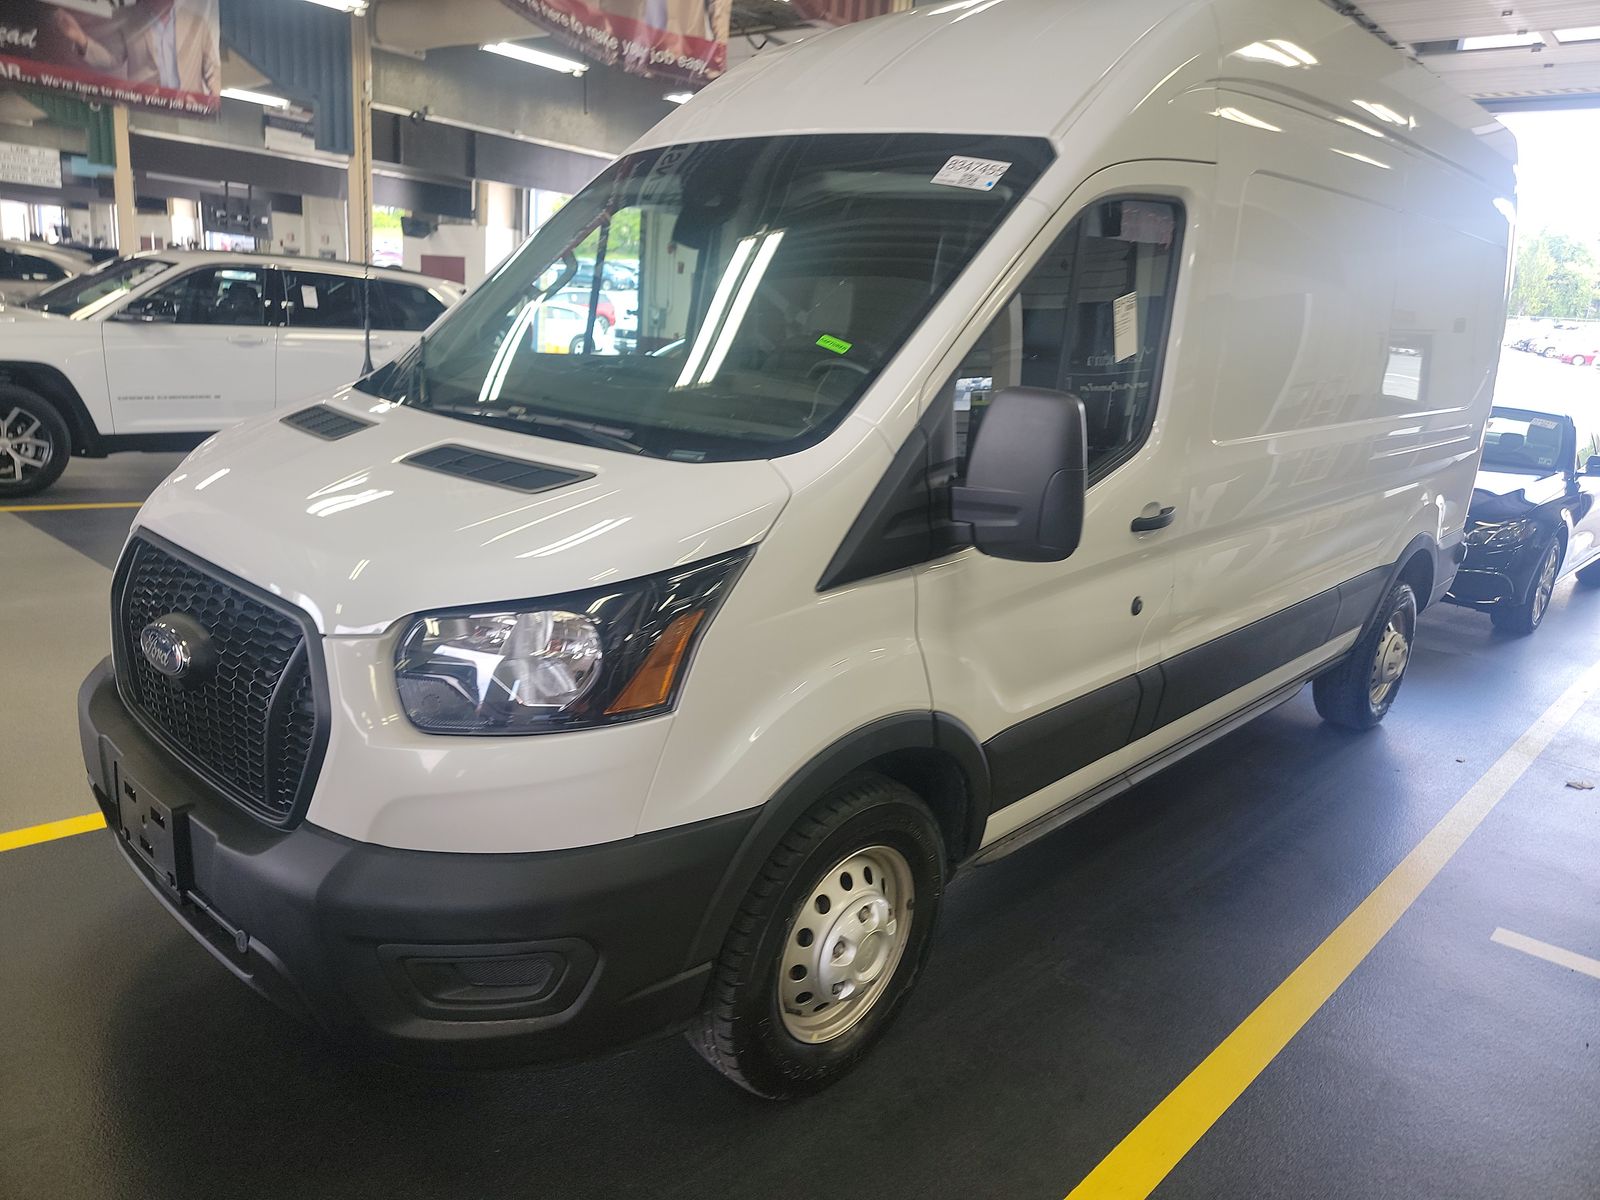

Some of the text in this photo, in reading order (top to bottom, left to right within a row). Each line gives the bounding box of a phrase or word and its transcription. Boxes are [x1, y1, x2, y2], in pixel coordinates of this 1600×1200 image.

[649, 47, 674, 65] job
[41, 74, 73, 90] We're
[75, 80, 98, 95] here
[101, 85, 112, 97] to
[115, 88, 142, 103] make
[145, 95, 167, 106] your
[168, 97, 184, 109] job
[145, 632, 171, 667] Ford
